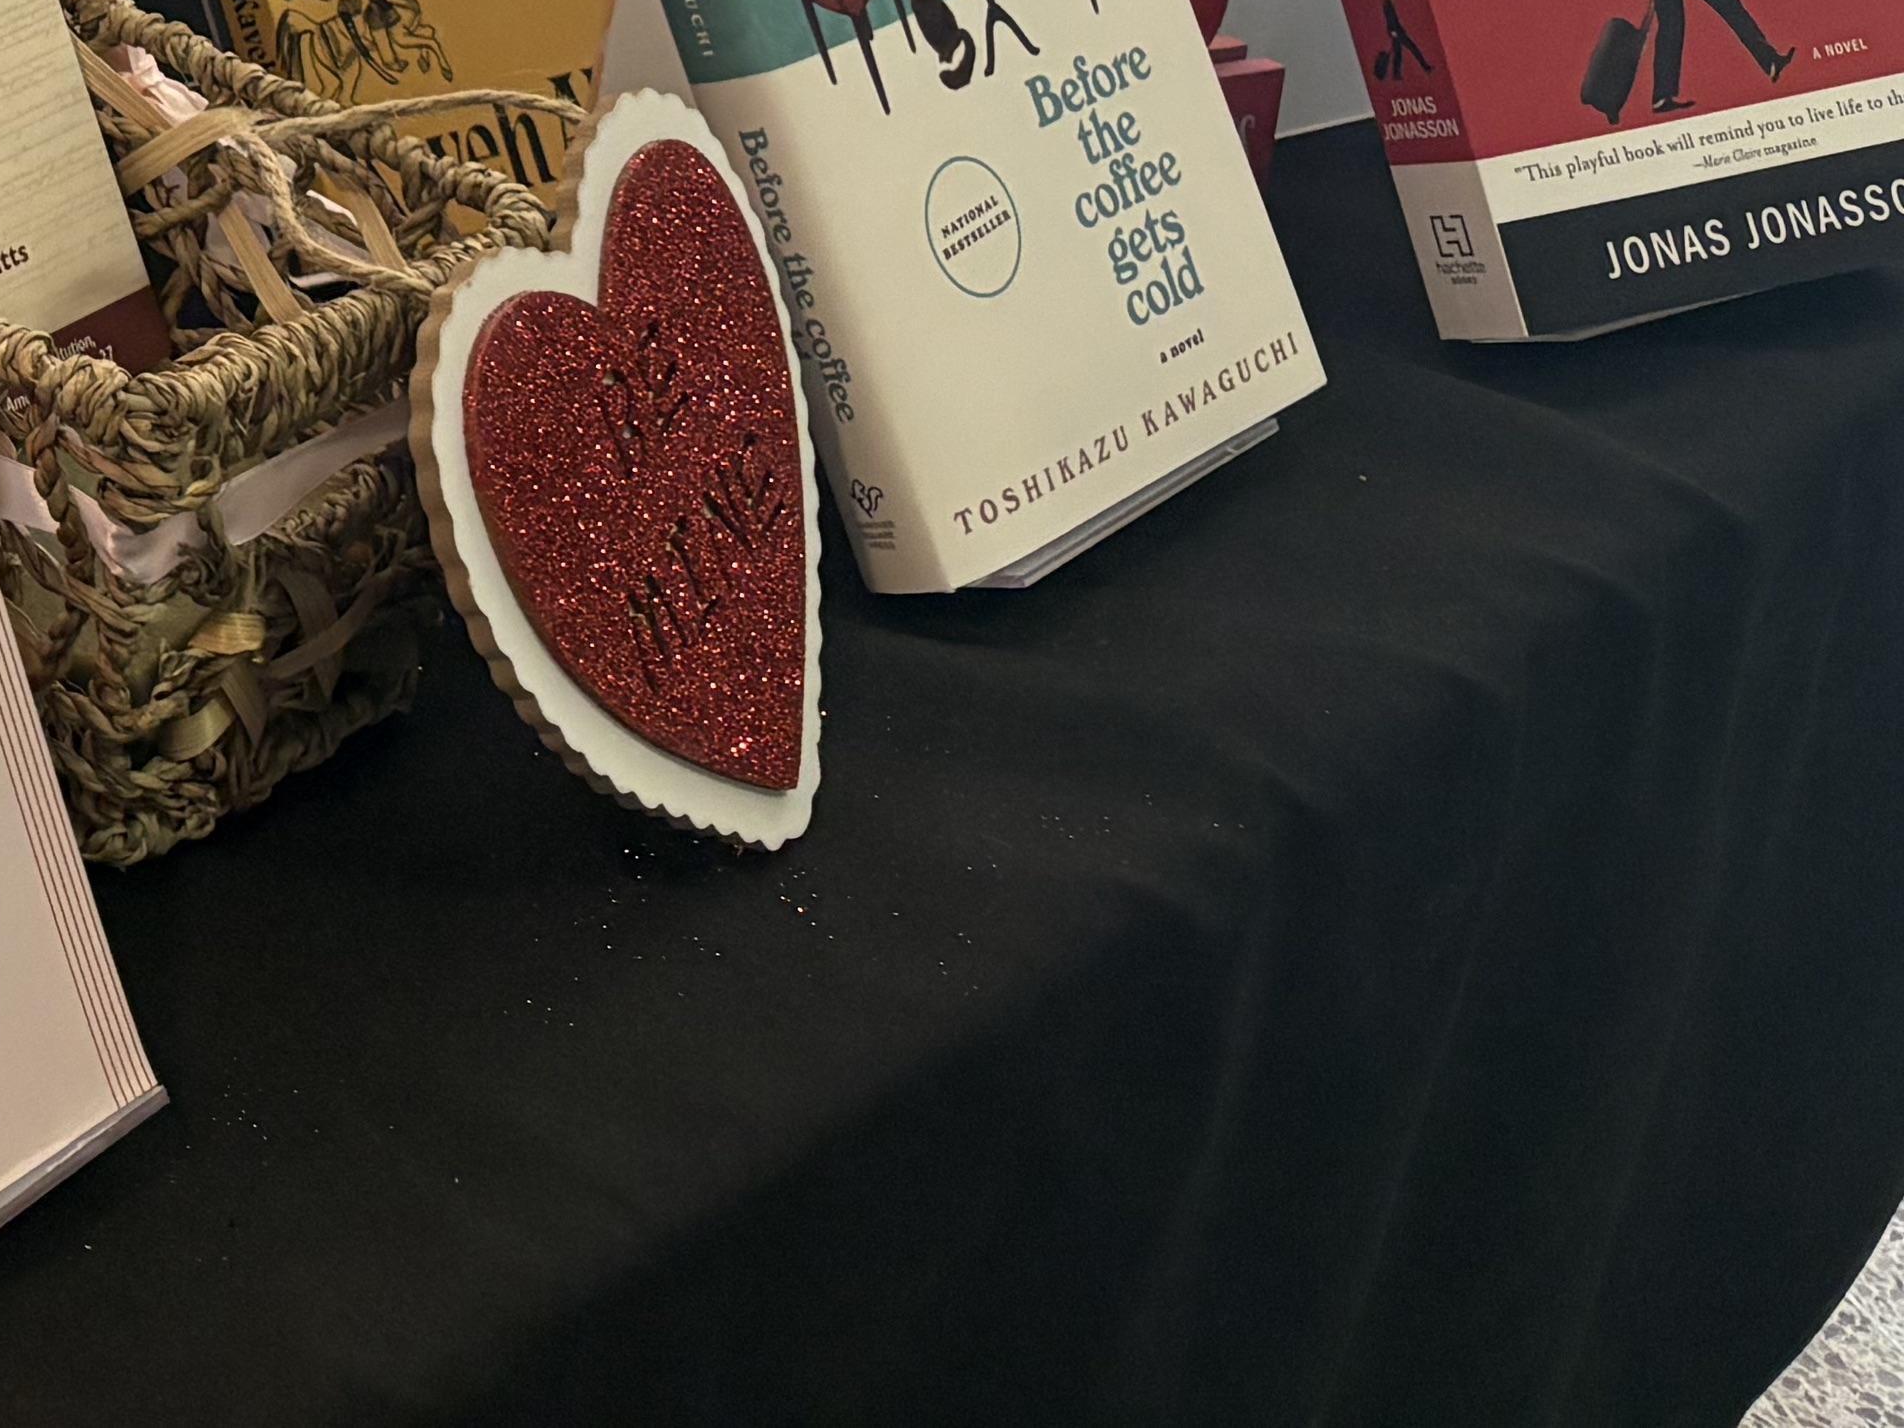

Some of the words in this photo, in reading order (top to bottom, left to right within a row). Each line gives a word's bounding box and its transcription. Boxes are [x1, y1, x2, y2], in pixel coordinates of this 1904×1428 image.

[1024, 38, 1154, 132] Before
[1073, 144, 1184, 230] coffee
[1604, 210, 1734, 280] JONAS
[1122, 249, 1207, 329] cold
[952, 425, 1130, 537] TOSHIKAZU
[1140, 331, 1301, 437] KAWAGUCHI
